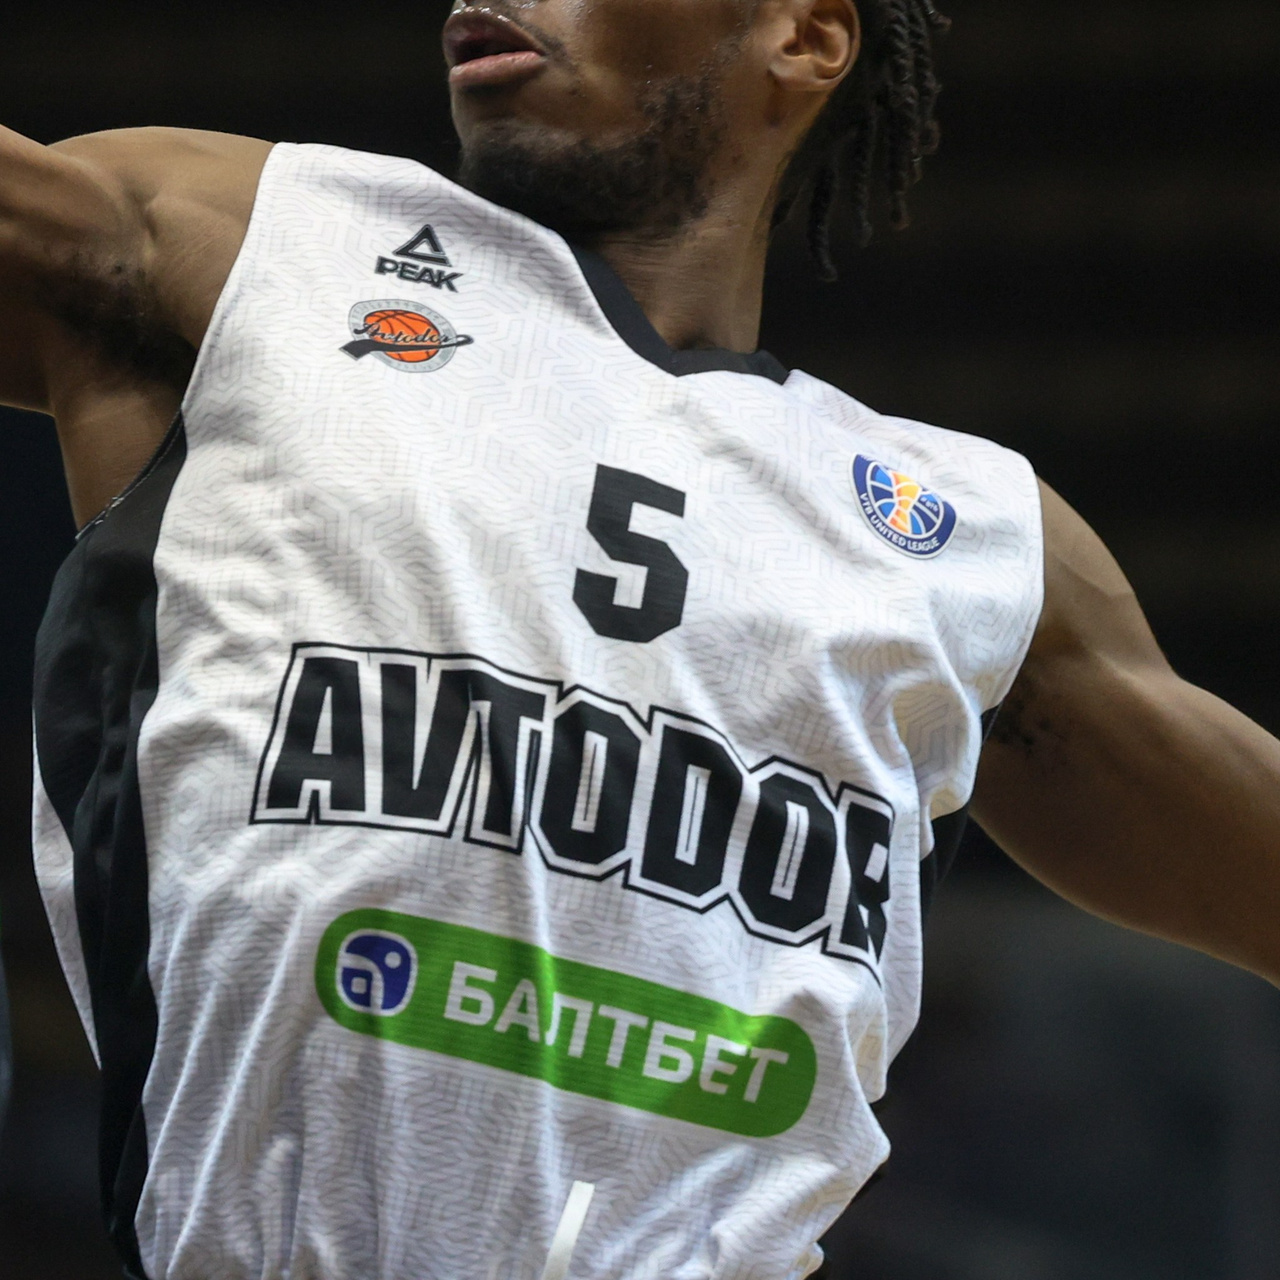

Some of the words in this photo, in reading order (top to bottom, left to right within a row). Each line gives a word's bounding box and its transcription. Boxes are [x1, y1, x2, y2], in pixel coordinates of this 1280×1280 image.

[374, 255, 464, 293] PEAK
[572, 463, 689, 643] 5
[860, 493, 874, 515] VTB
[870, 515, 907, 548] UNITED
[907, 537, 940, 552] LEAGUE
[249, 642, 894, 985] AVTODOR
[443, 960, 789, 1104] БАЛТБЕТ
